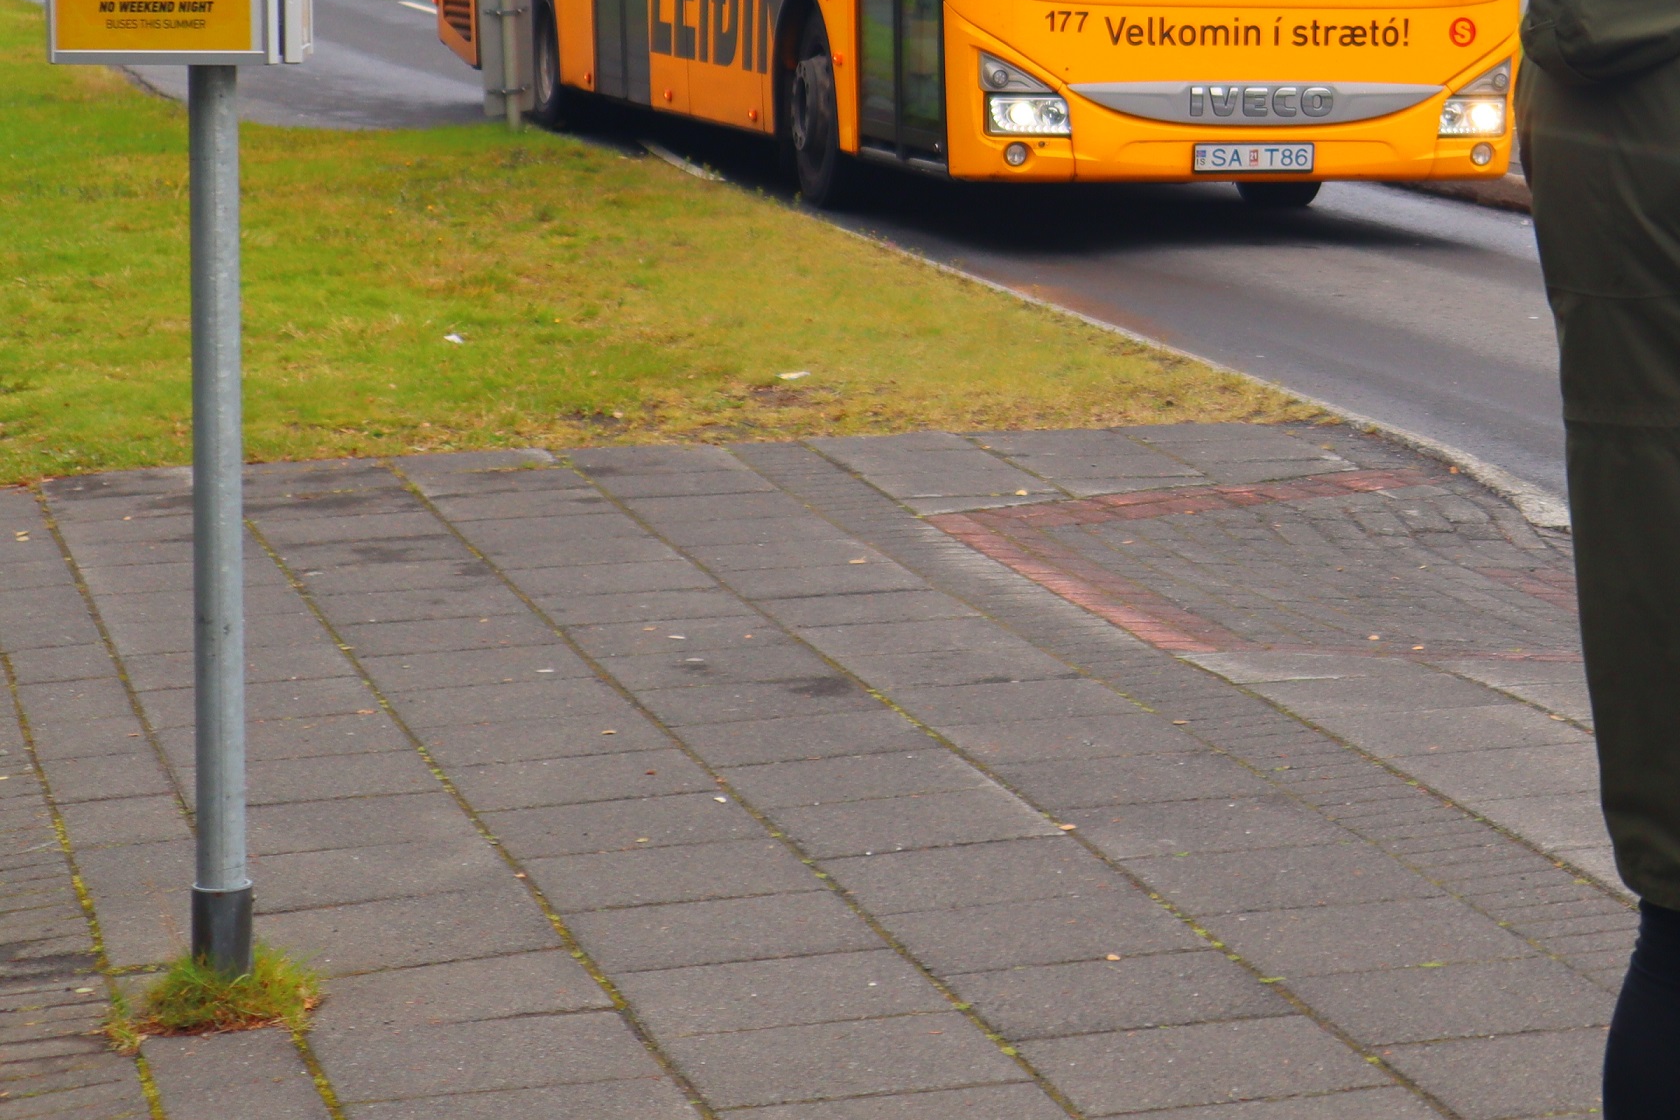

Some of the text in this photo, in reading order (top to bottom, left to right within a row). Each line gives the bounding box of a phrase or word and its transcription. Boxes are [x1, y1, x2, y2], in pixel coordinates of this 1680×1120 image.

[99, 1, 214, 13] NO WEEKEND NIGHT
[106, 19, 206, 29] BUSES THIS SUMMER
[1045, 11, 1473, 47] 177 Velkomin í strætó! S
[1189, 86, 1334, 118] IVECO
[1211, 148, 1308, 167] SA T86
